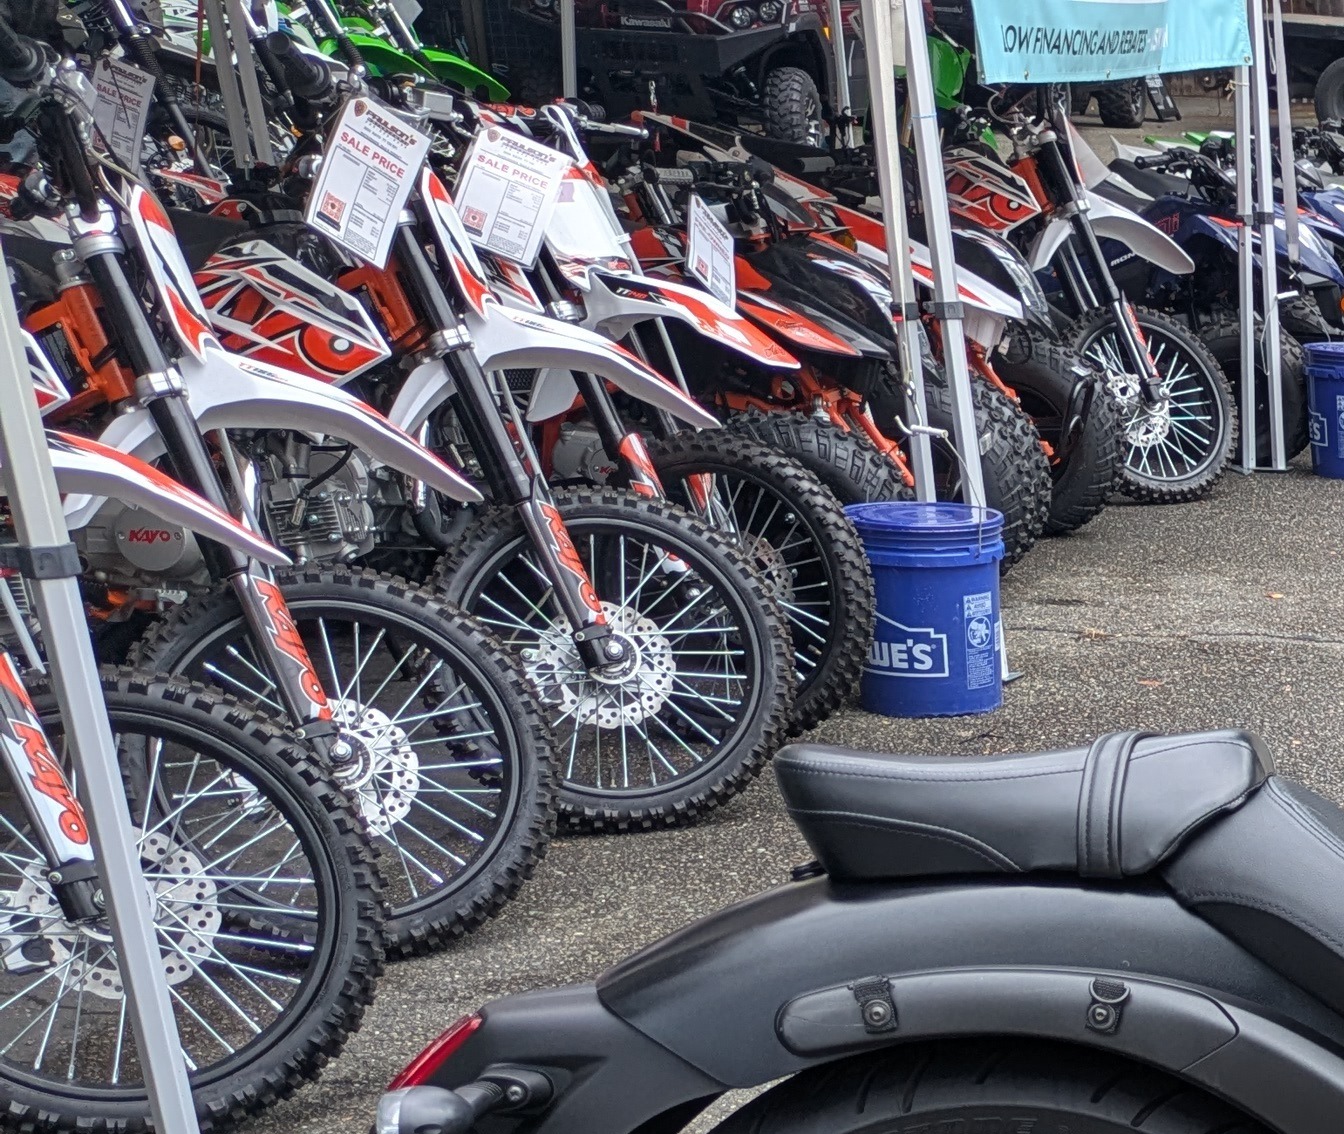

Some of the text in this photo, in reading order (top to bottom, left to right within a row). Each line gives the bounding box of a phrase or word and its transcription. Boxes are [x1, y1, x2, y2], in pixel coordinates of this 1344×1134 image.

[620, 16, 673, 28] Kawasaki
[1034, 27, 1097, 56] FINANCING
[1096, 29, 1121, 55] AND
[96, 83, 117, 97] SALE
[340, 131, 369, 155] SALE
[371, 152, 406, 179] PRICE
[477, 154, 549, 189] SALE PRICE
[128, 528, 171, 544] KAYO
[868, 639, 933, 671] WE'S
